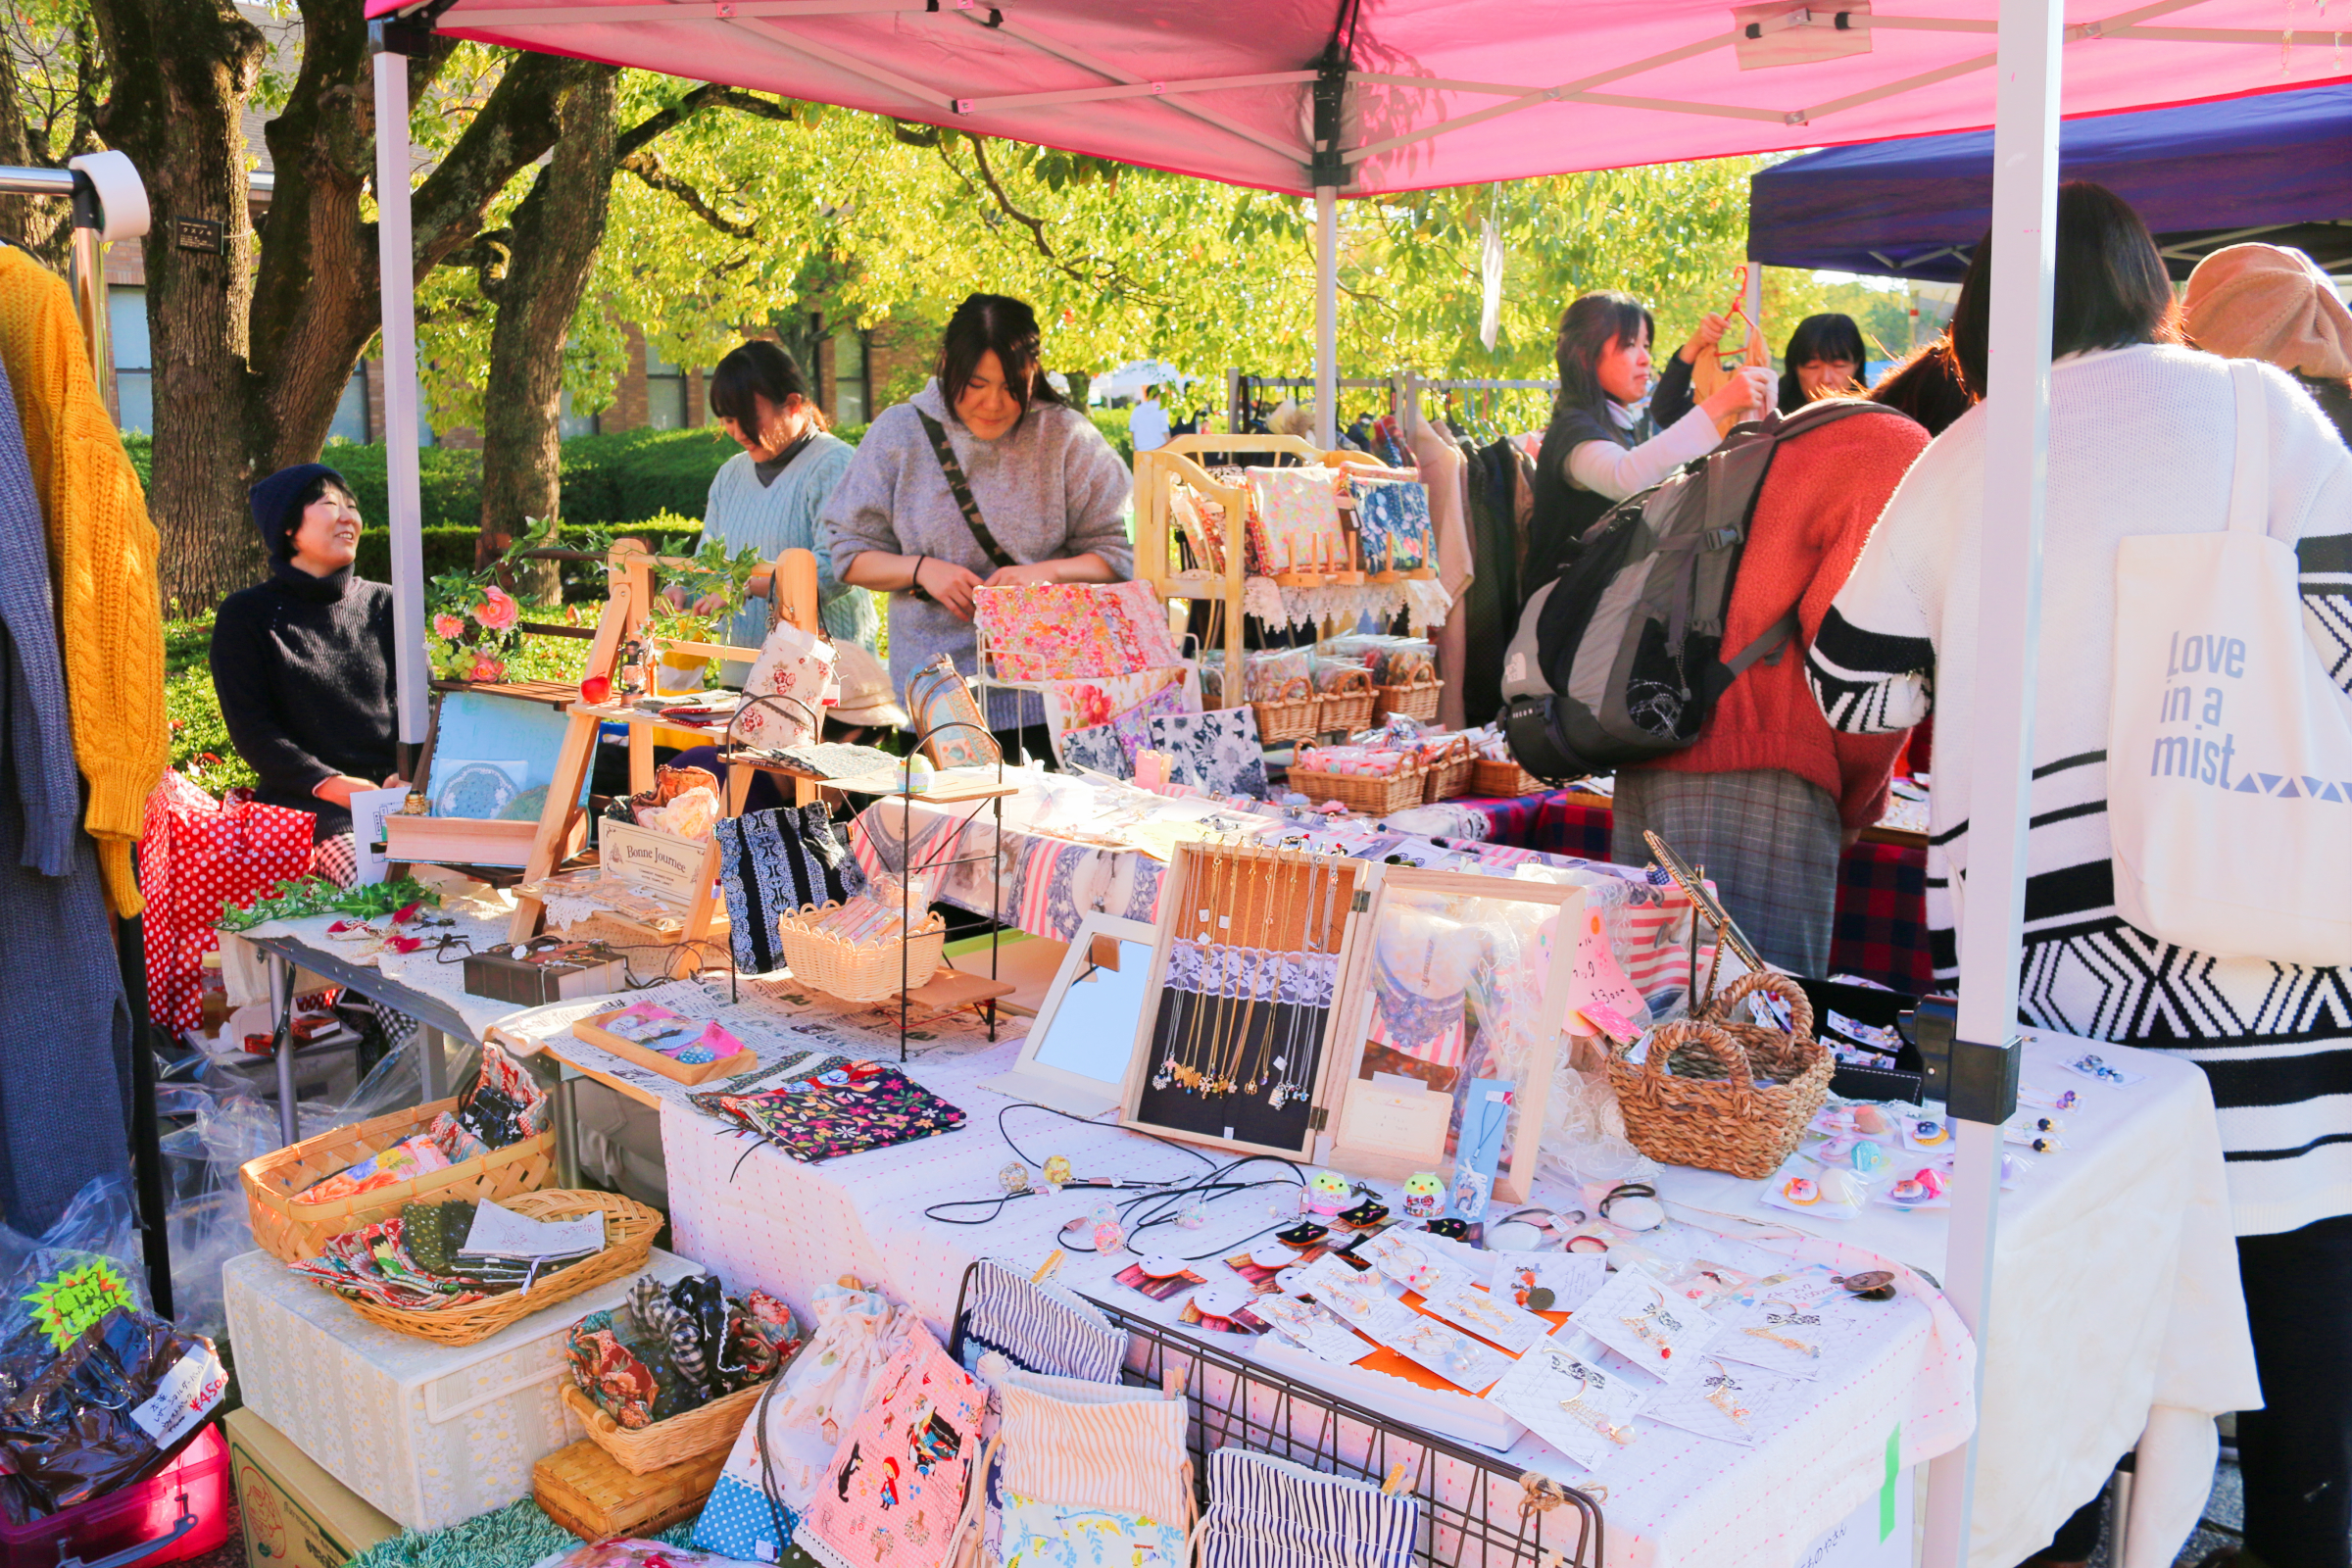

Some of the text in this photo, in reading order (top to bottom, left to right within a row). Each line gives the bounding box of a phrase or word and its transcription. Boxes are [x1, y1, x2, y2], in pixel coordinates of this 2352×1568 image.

[2166, 630, 2246, 679] Love
[2160, 678, 2224, 727] in a
[2150, 723, 2235, 790] mist
[626, 845, 653, 858] Bonne
[53, 1272, 101, 1315] 値下げ
[189, 1372, 229, 1412] ¥4500
[1799, 1522, 1847, 1568] ものやさん
